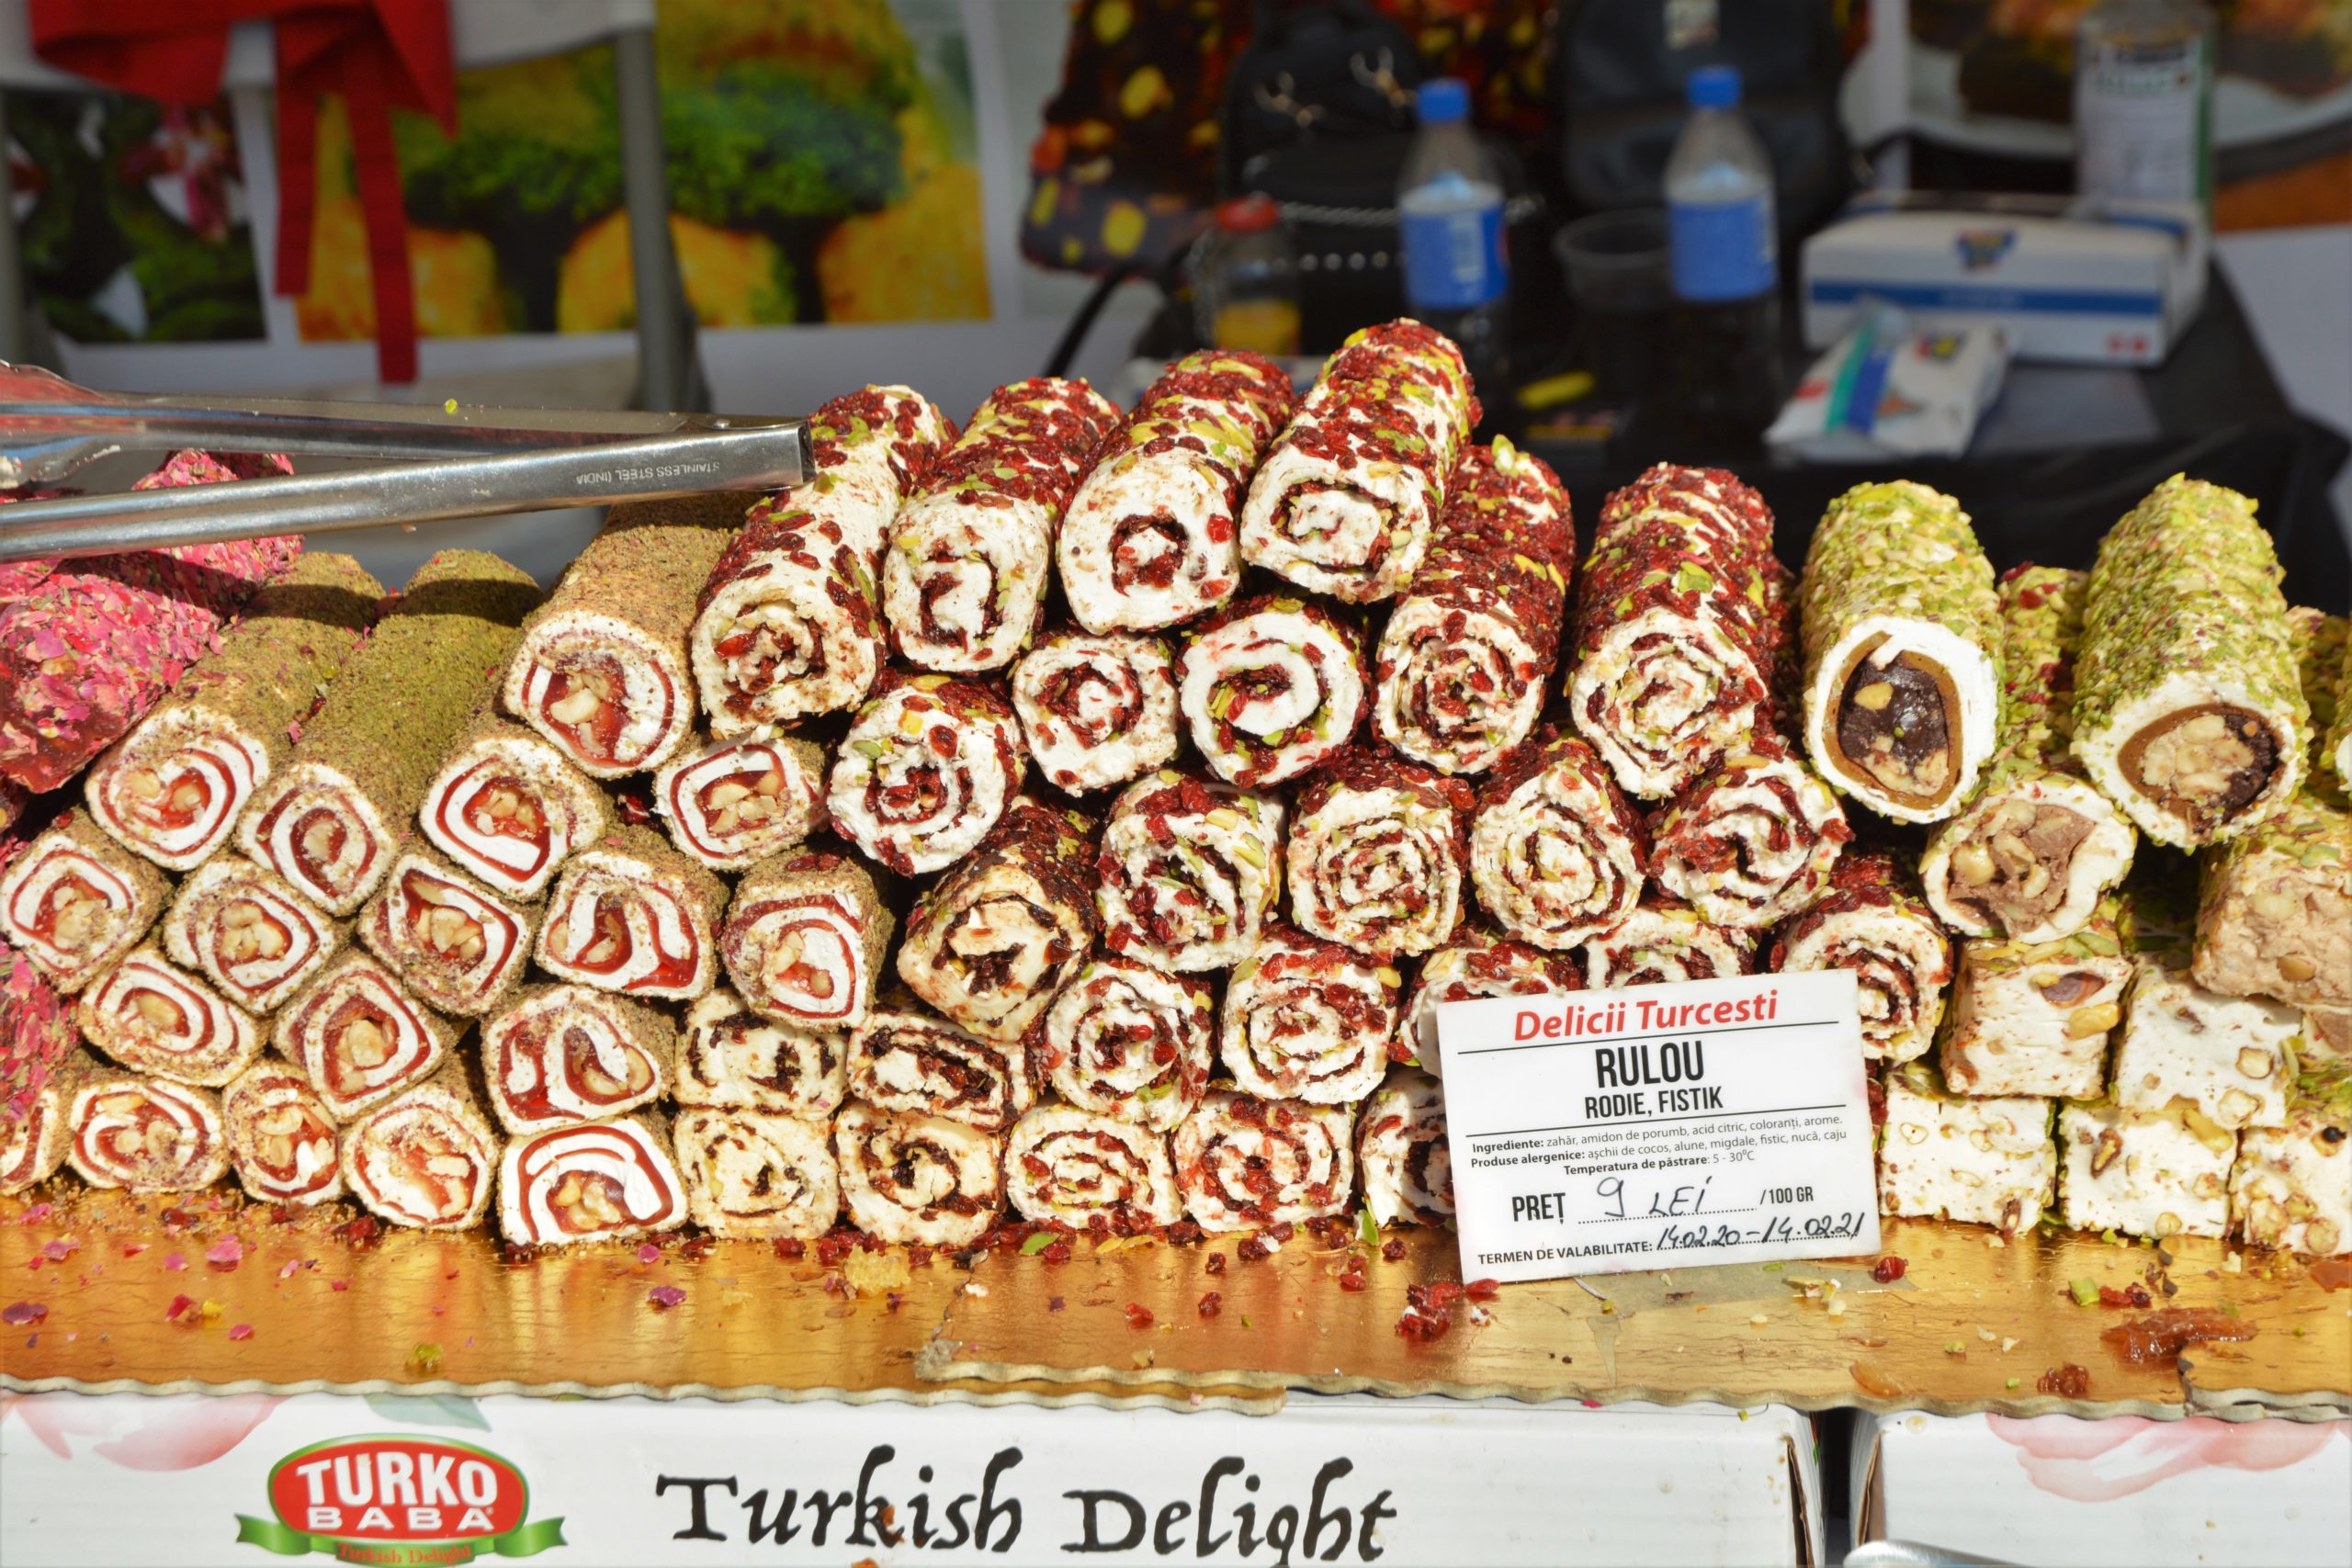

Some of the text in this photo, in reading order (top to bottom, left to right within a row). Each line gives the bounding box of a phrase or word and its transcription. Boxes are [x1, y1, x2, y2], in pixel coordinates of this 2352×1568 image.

[616, 466, 653, 481] STEEL
[656, 461, 720, 478] STAINLESS
[1514, 989, 1778, 1041] Delicii Turcesti
[1595, 1040, 1705, 1089] RULOU
[1584, 1086, 1724, 1120] RODIE, FISTIK
[1471, 1154, 1519, 1168] Produse
[1521, 1150, 1586, 1166] alergenice:
[1622, 1145, 1635, 1156] de
[1638, 1143, 1672, 1155] cocos,
[1674, 1139, 1708, 1153] alune,
[1710, 1135, 1758, 1150] migdale,
[1760, 1134, 1789, 1146] fistic,
[1792, 1131, 1821, 1143] nucă,
[1824, 1129, 1848, 1141] caju
[1472, 1139, 1544, 1155] Ingrediente:
[1546, 1134, 1578, 1148] zahăr,
[1581, 1131, 1623, 1145] amidon
[1625, 1130, 1640, 1141] de
[1643, 1125, 1690, 1145] porumb,
[1692, 1123, 1715, 1135] acid
[1717, 1121, 1747, 1134] citric,
[1804, 1115, 1843, 1126] arome.
[1564, 1158, 1639, 1176] Temperatura
[1641, 1157, 1656, 1169] de
[1658, 1155, 1712, 1170] păstrare:
[1713, 1153, 1720, 1164] 5
[1597, 1176, 1625, 1218] 9
[1759, 1187, 1792, 1205] /100
[1796, 1186, 1815, 1202] GR
[1478, 1250, 1533, 1265] TERMEN
[1536, 1248, 1555, 1260] DE
[1556, 1241, 1653, 1259] VALABILITATE:
[296, 1451, 498, 1506] TURKO
[307, 1506, 495, 1531] BABA
[656, 1444, 1397, 1568] Turkish Delight
[337, 1541, 472, 1566] Turkish Delight
